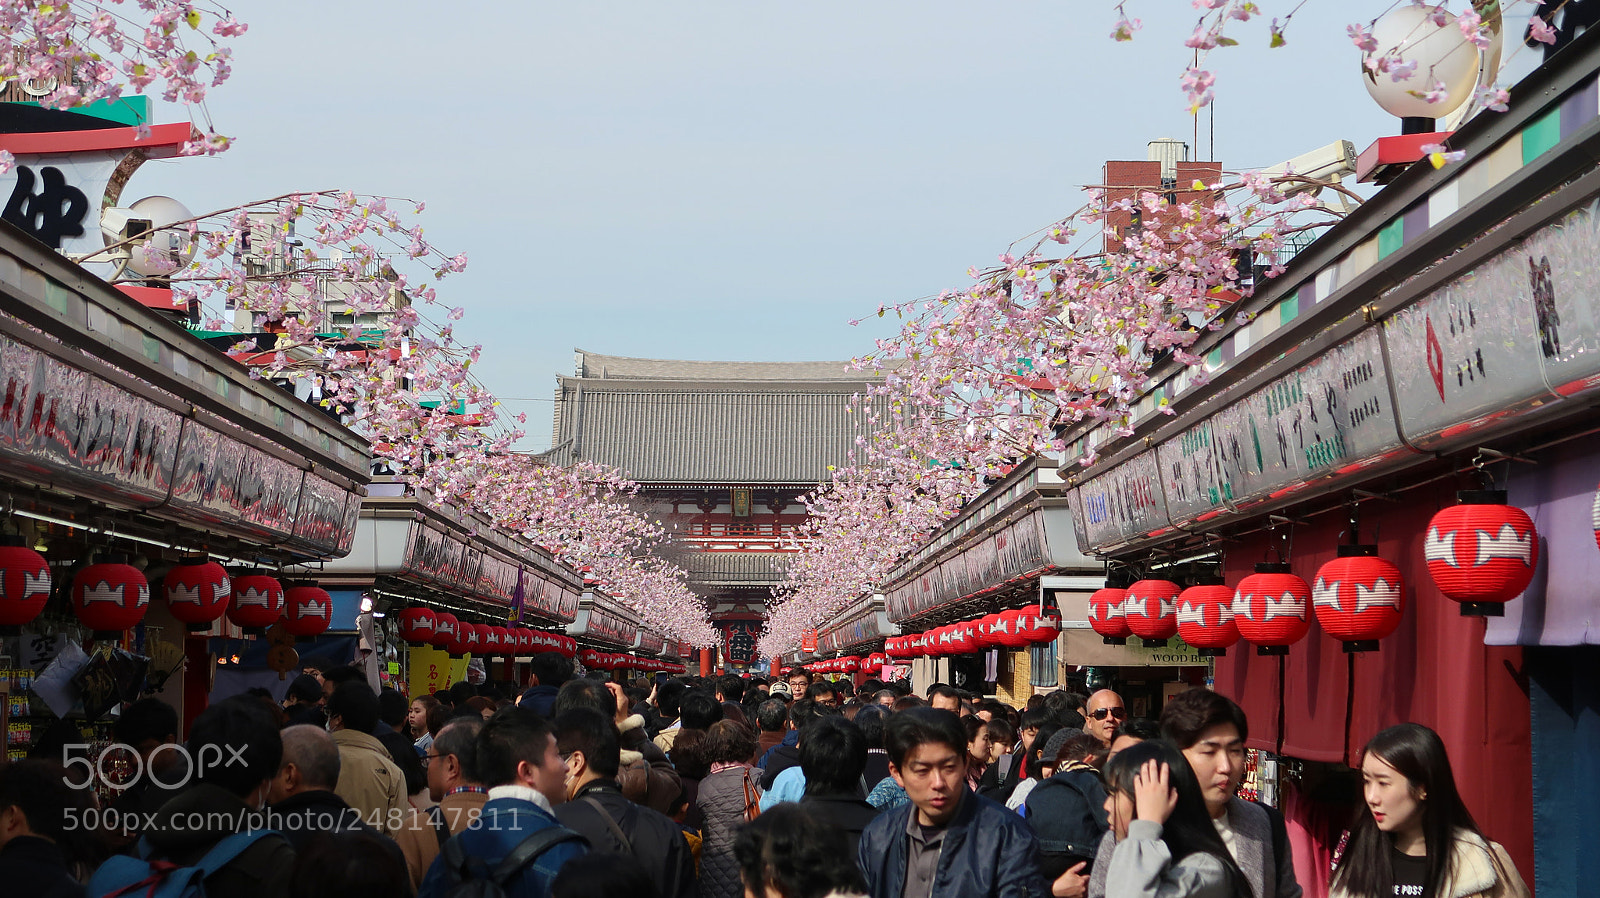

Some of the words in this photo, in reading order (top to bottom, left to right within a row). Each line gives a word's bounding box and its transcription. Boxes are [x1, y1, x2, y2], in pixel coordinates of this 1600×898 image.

[729, 622, 756, 662] 小舟町
[1153, 654, 1187, 662] WOOD
